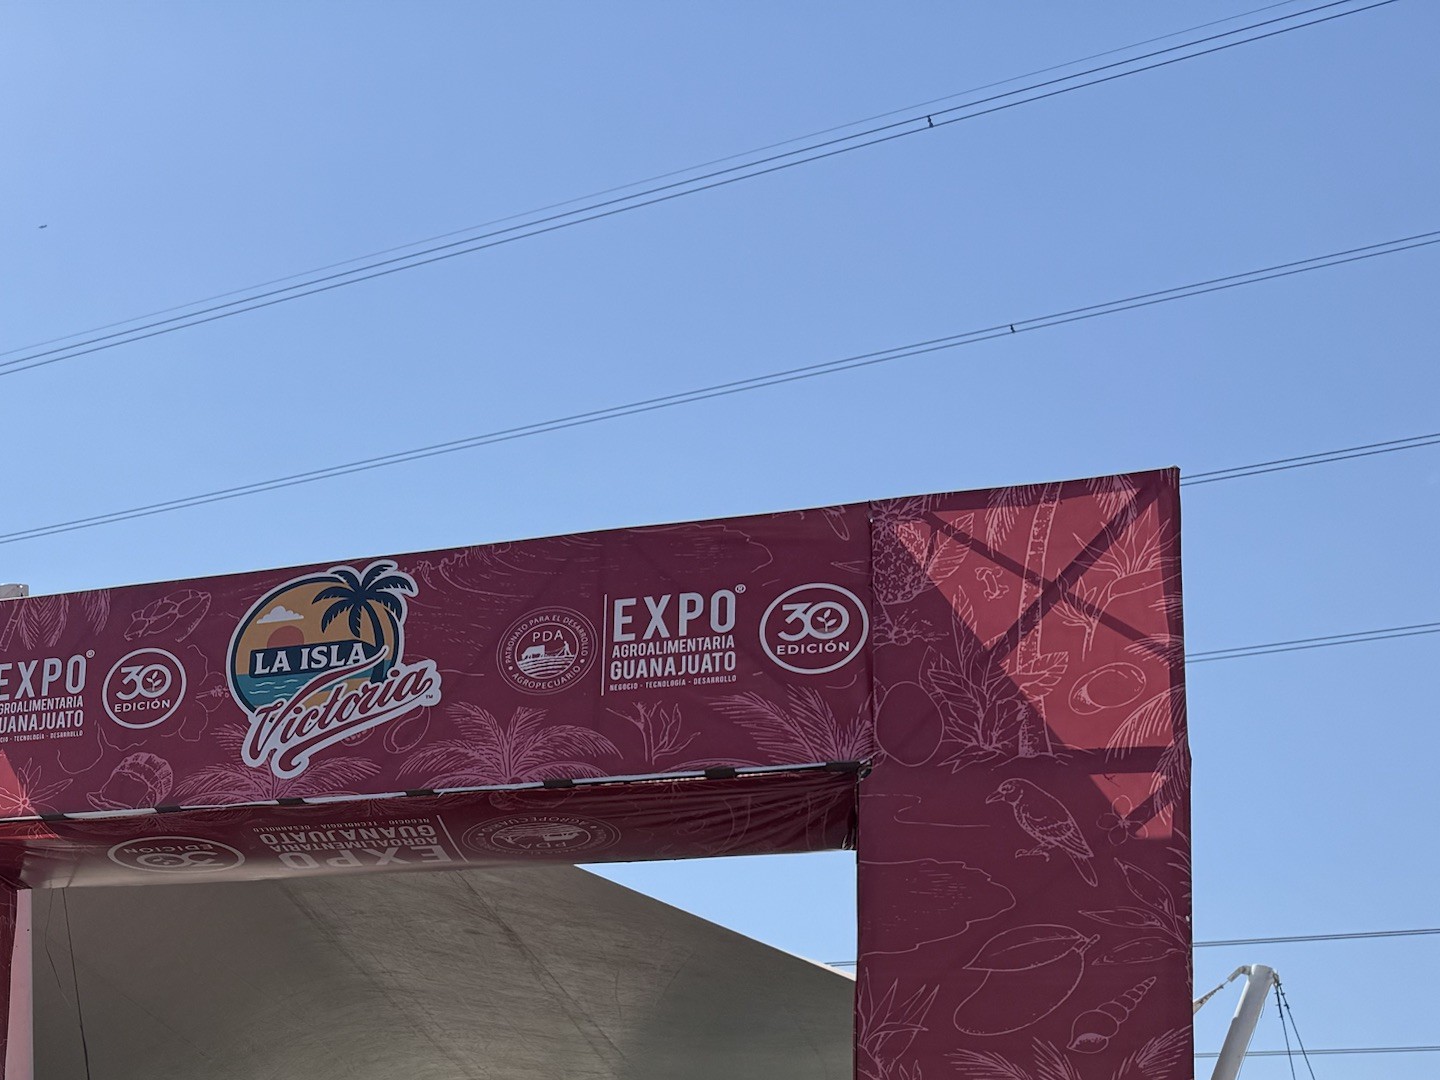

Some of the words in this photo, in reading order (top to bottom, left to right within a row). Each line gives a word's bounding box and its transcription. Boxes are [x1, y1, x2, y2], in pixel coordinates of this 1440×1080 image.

[778, 601, 850, 641] 30
[532, 630, 563, 642] PDA
[612, 635, 735, 659] AGROALIMENTARIA
[777, 640, 849, 655] EDICIÓN
[254, 650, 292, 675] LA
[300, 643, 366, 669] ISLA
[610, 651, 736, 680] GUANAJUATO
[116, 664, 172, 700] 30
[512, 666, 580, 689] AGROPECUARIO
[609, 682, 639, 691] NEGOCIO
[693, 675, 736, 685] DESARROLLO
[114, 698, 170, 713] EDICIÓN
[248, 653, 436, 772] Victoria
[259, 825, 437, 845] GUANAJUATO
[269, 837, 438, 852] AGROALIMENTARIA
[136, 851, 224, 868] 30
